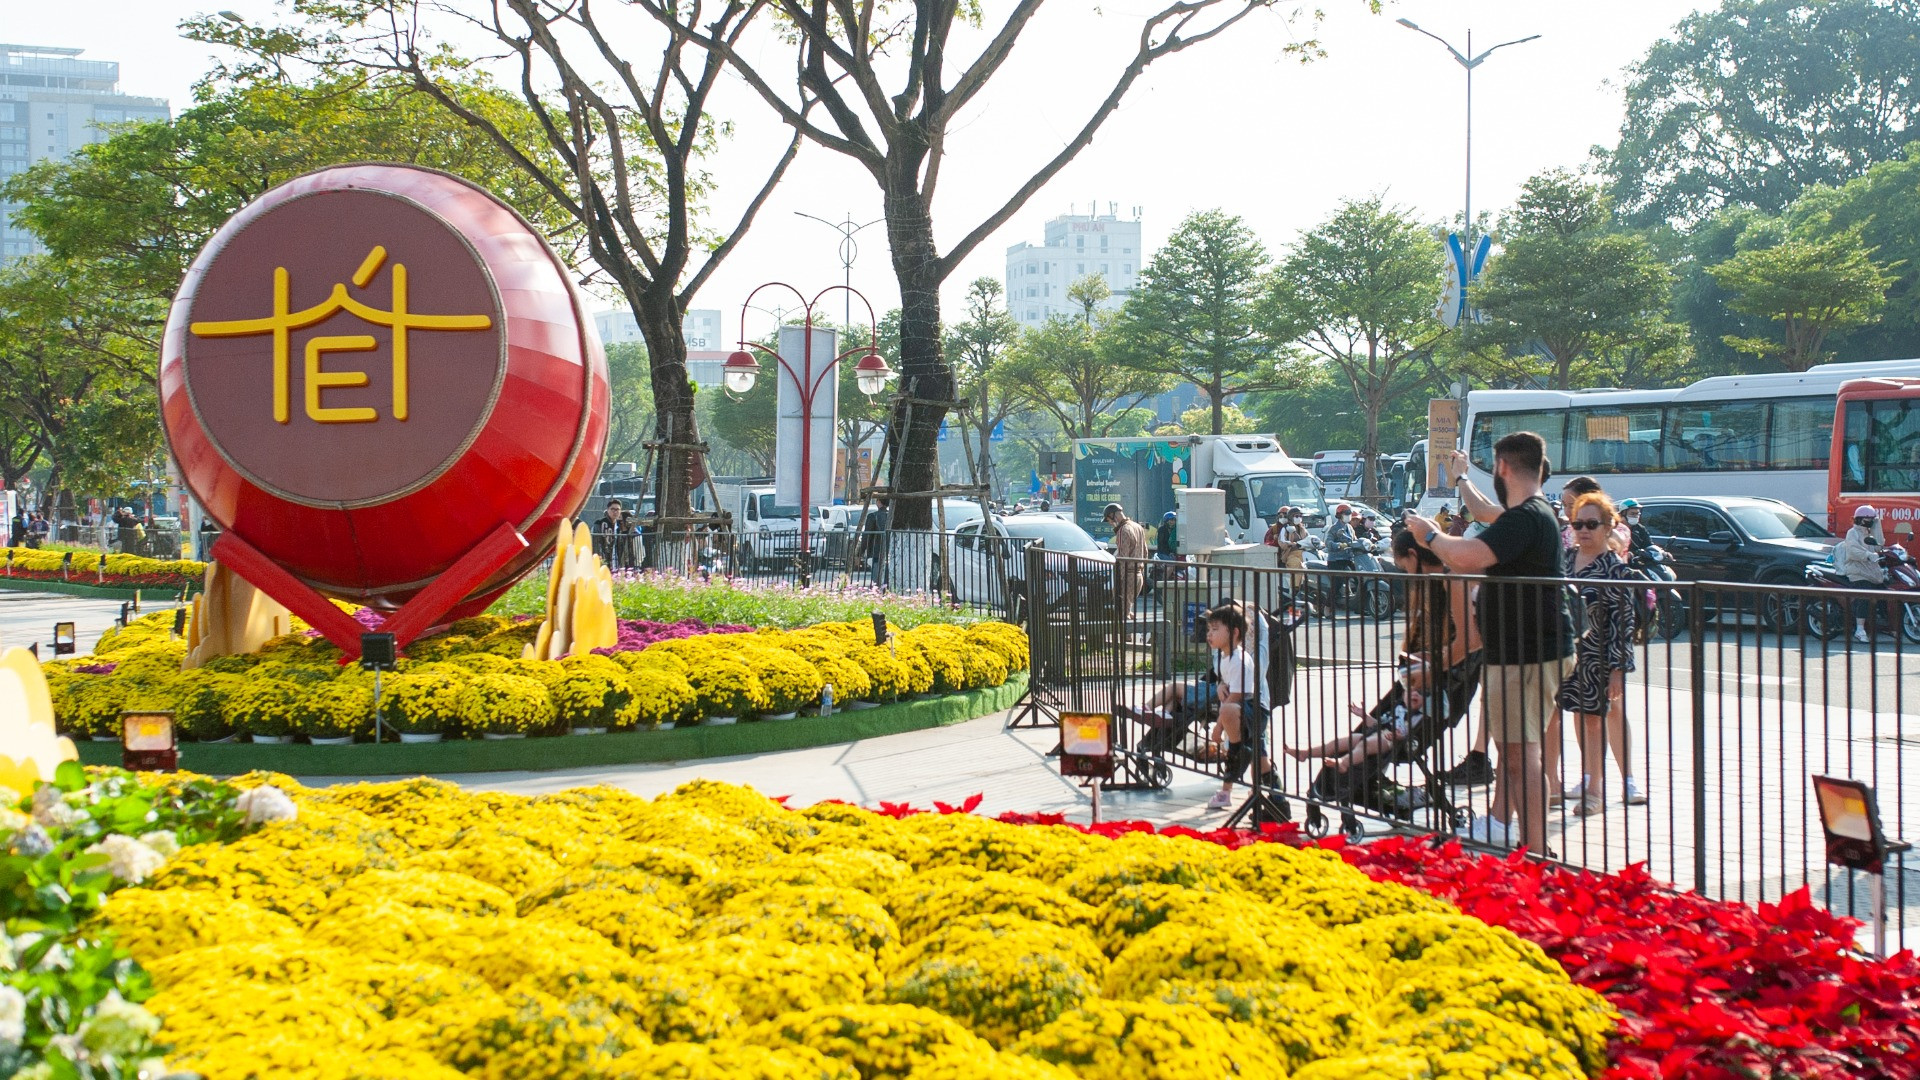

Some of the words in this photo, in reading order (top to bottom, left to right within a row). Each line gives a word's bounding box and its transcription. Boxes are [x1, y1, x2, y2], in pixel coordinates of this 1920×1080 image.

[1105, 480, 1121, 488] Supplier
[1086, 494, 1100, 502] ITALIAN
[1108, 494, 1121, 502] CREAM
